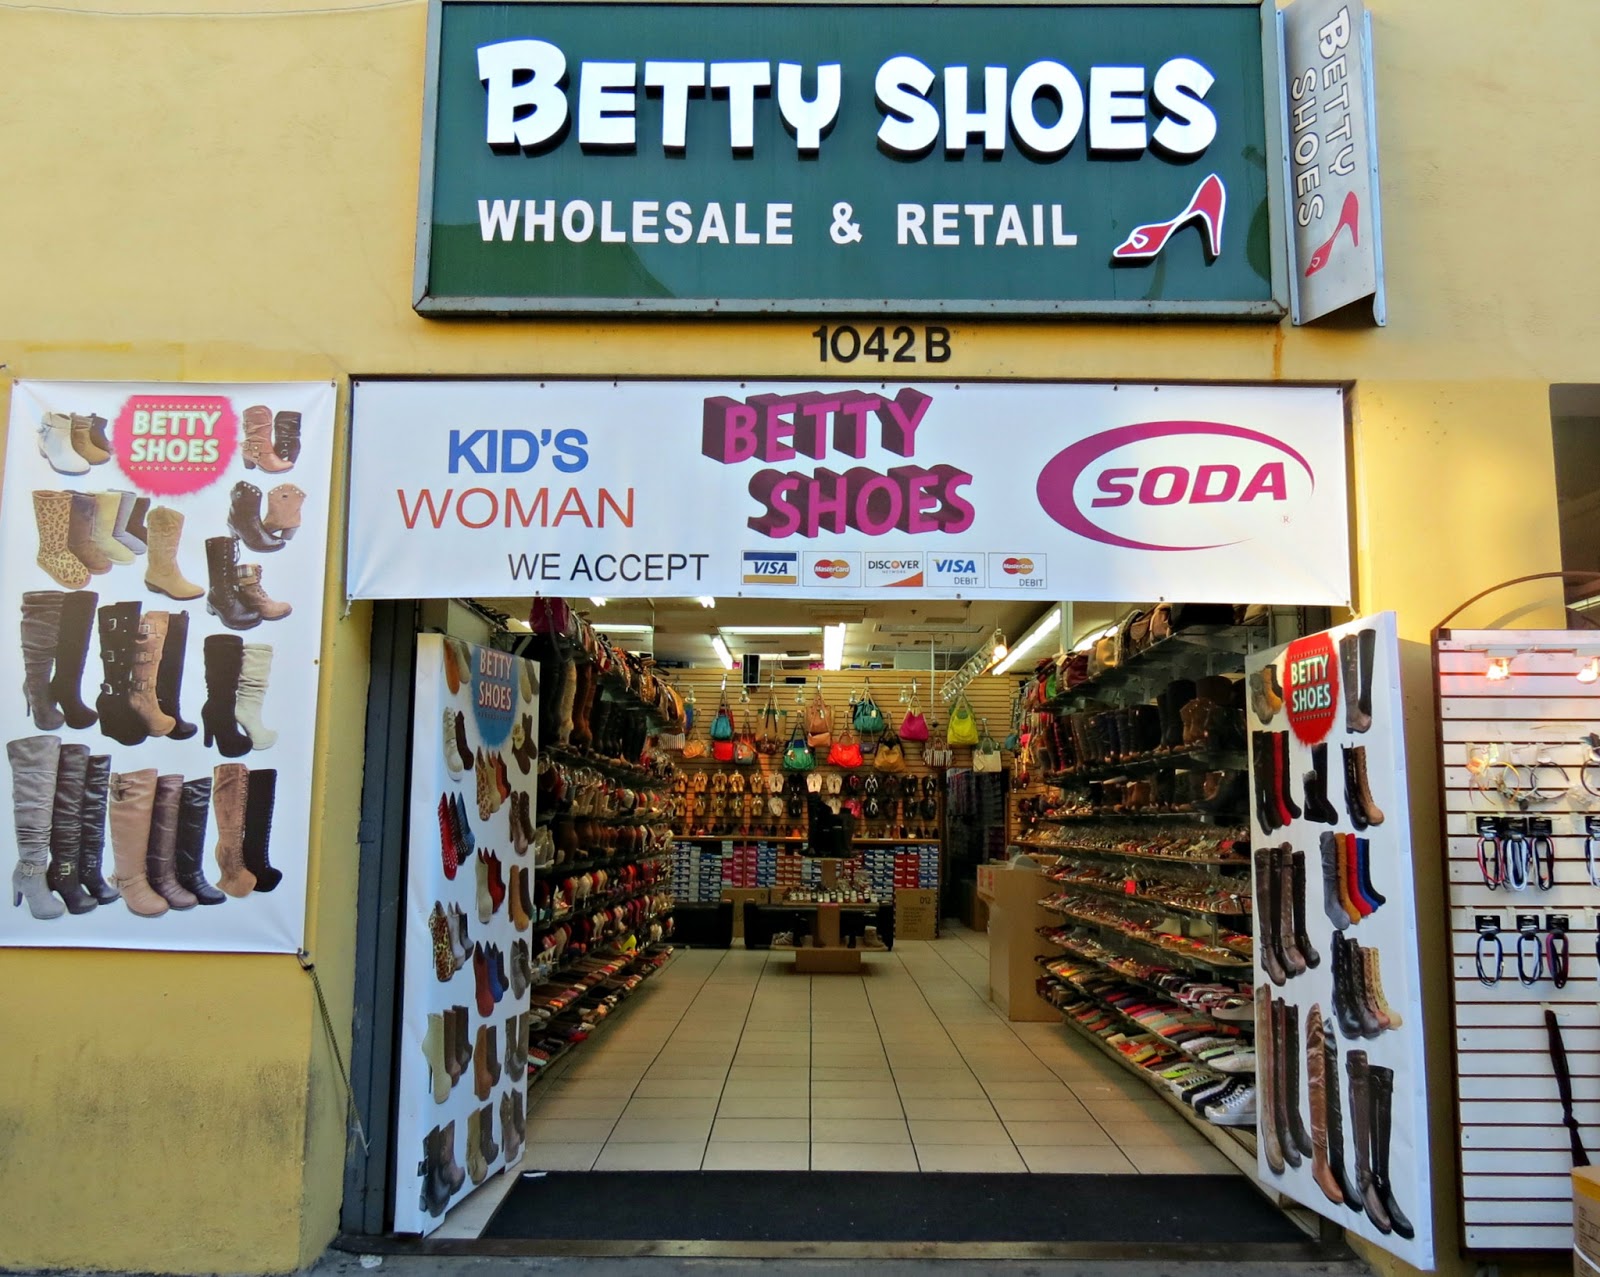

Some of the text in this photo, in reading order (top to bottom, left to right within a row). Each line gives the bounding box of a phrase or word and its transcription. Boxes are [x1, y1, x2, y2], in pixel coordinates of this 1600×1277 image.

[477, 40, 1218, 154] BETTY SHOES
[1319, 5, 1355, 176] BETTY
[1291, 67, 1325, 227] SHOES
[478, 199, 1078, 246] WHOLESALE & RETAIL
[131, 411, 222, 436] BETTY
[702, 387, 933, 464] BETTY
[130, 438, 220, 464] SHOES
[448, 428, 589, 474] KID'S
[1091, 462, 1287, 508] SODA
[397, 487, 635, 529] WOMAN
[747, 464, 976, 539] SHOES
[508, 553, 709, 582] WE ACCEPT
[753, 561, 788, 574] VISA
[868, 560, 919, 570] DISCOVER
[932, 559, 976, 573] VISA
[953, 577, 978, 585] DEBIT
[1018, 578, 1044, 587] DEBIT
[480, 648, 513, 680] BETTY
[1290, 654, 1329, 687] BETTY
[478, 680, 512, 711] SHOES
[1291, 683, 1331, 713] SHOES
